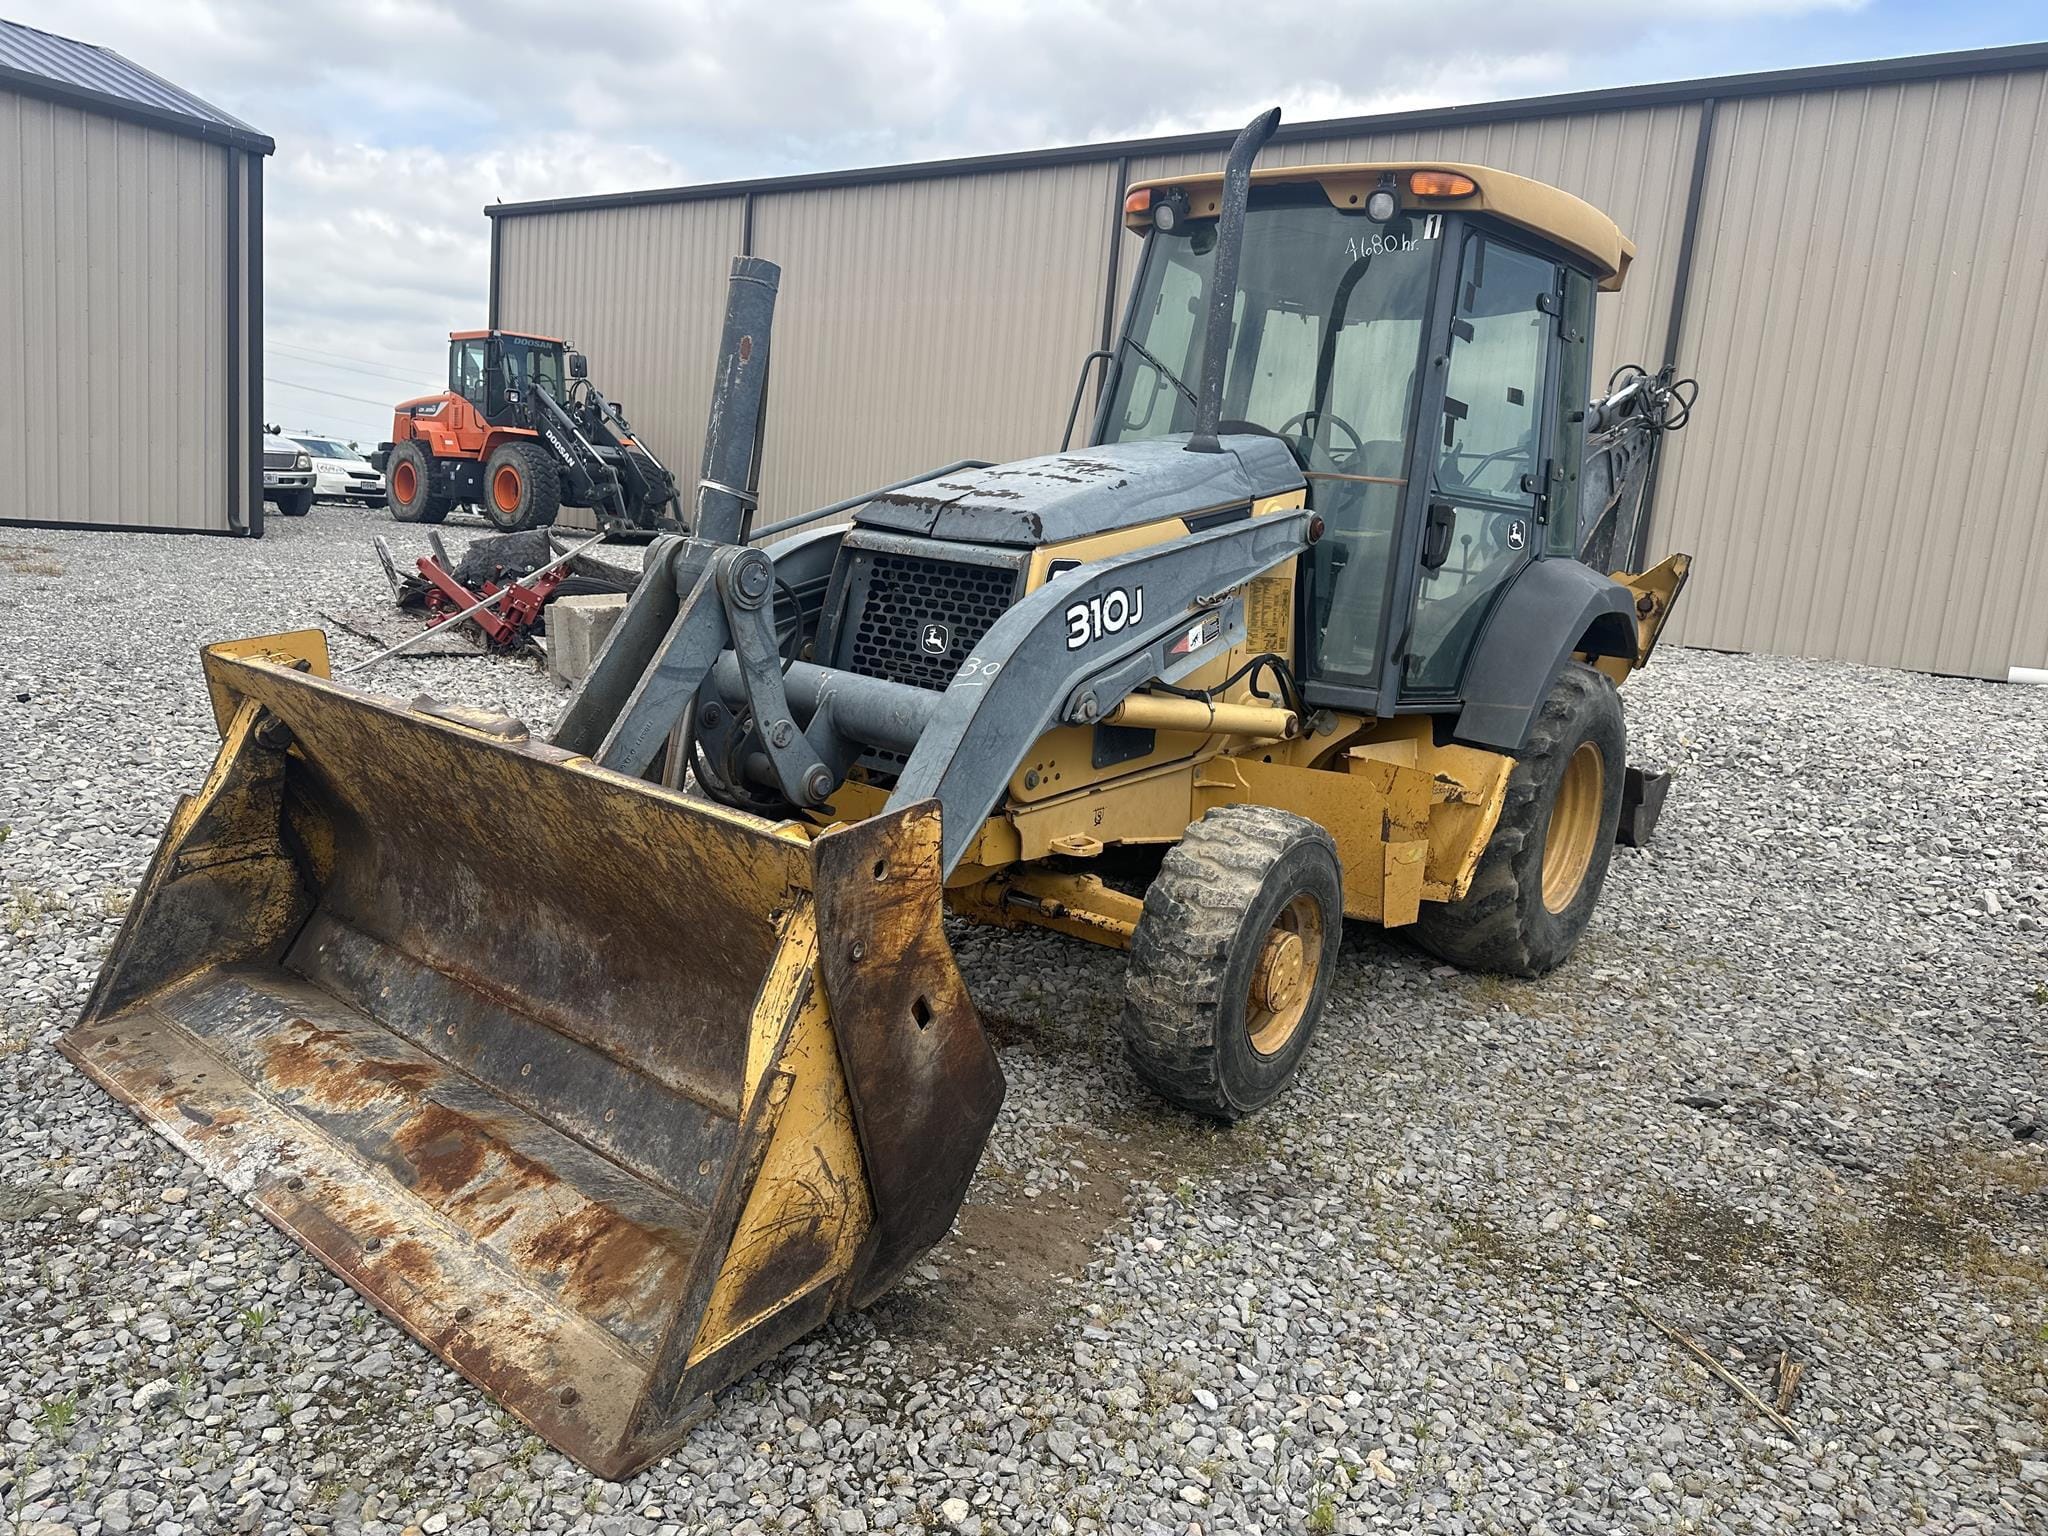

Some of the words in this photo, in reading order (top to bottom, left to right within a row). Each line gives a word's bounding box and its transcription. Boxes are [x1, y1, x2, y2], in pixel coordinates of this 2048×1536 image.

[513, 337, 553, 349] DOOSAN
[545, 429, 576, 467] DOOSAN
[1066, 587, 1143, 650] 310J
[956, 657, 1000, 677] 30
